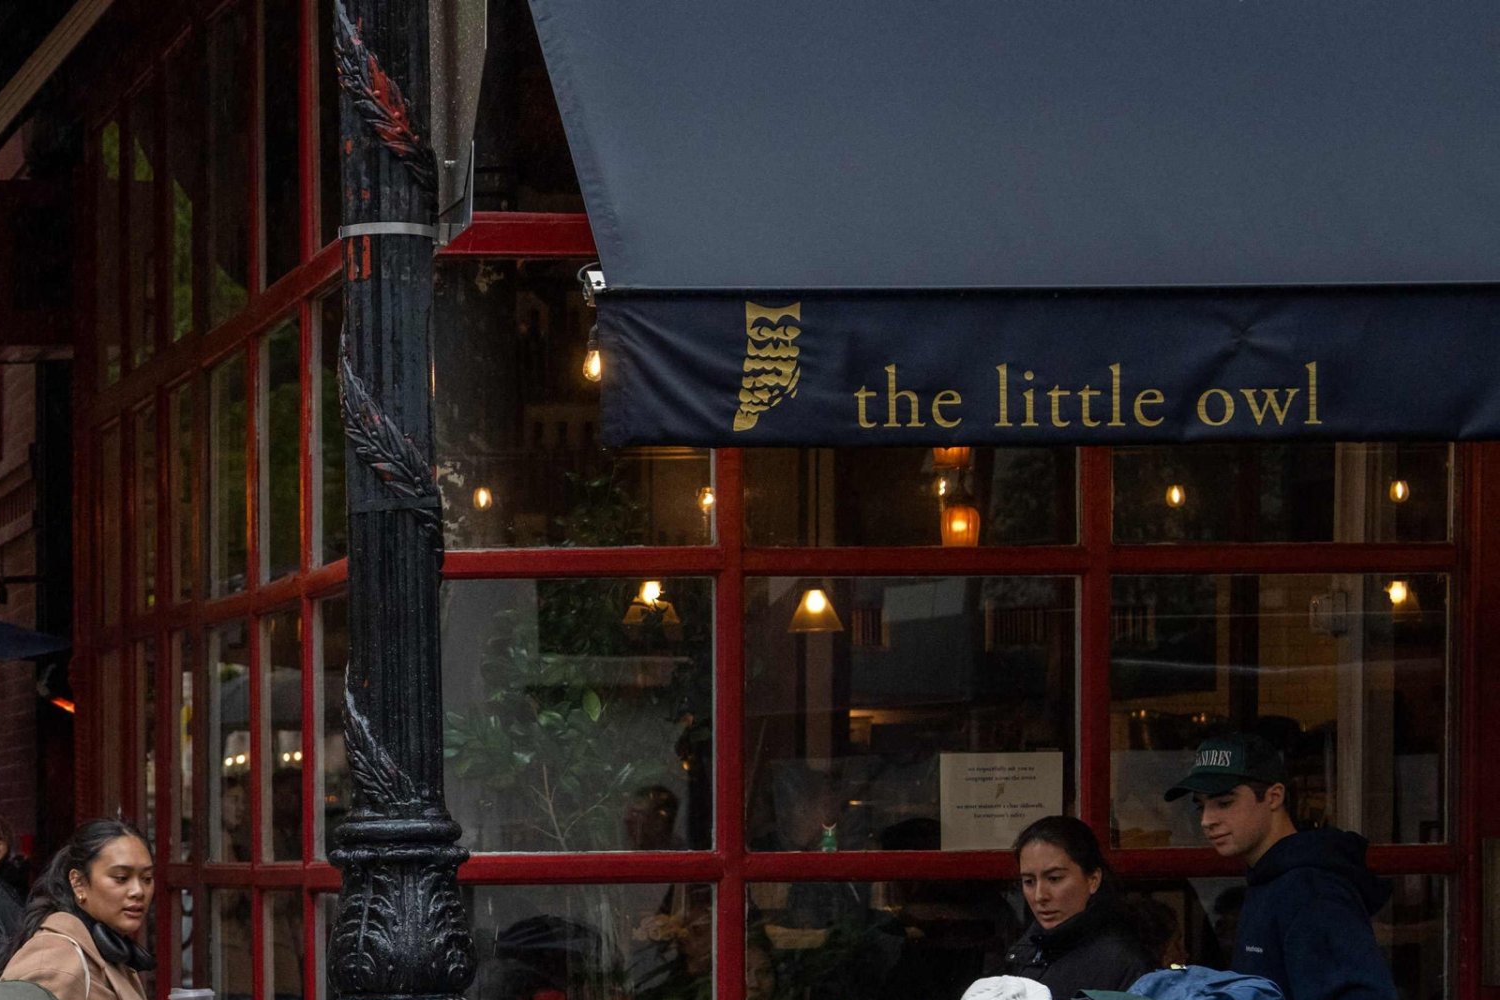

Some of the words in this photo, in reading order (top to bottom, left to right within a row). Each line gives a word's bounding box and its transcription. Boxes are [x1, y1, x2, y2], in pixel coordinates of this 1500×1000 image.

[854, 363, 964, 429] the
[994, 362, 1166, 428] little
[1196, 360, 1323, 427] owl
